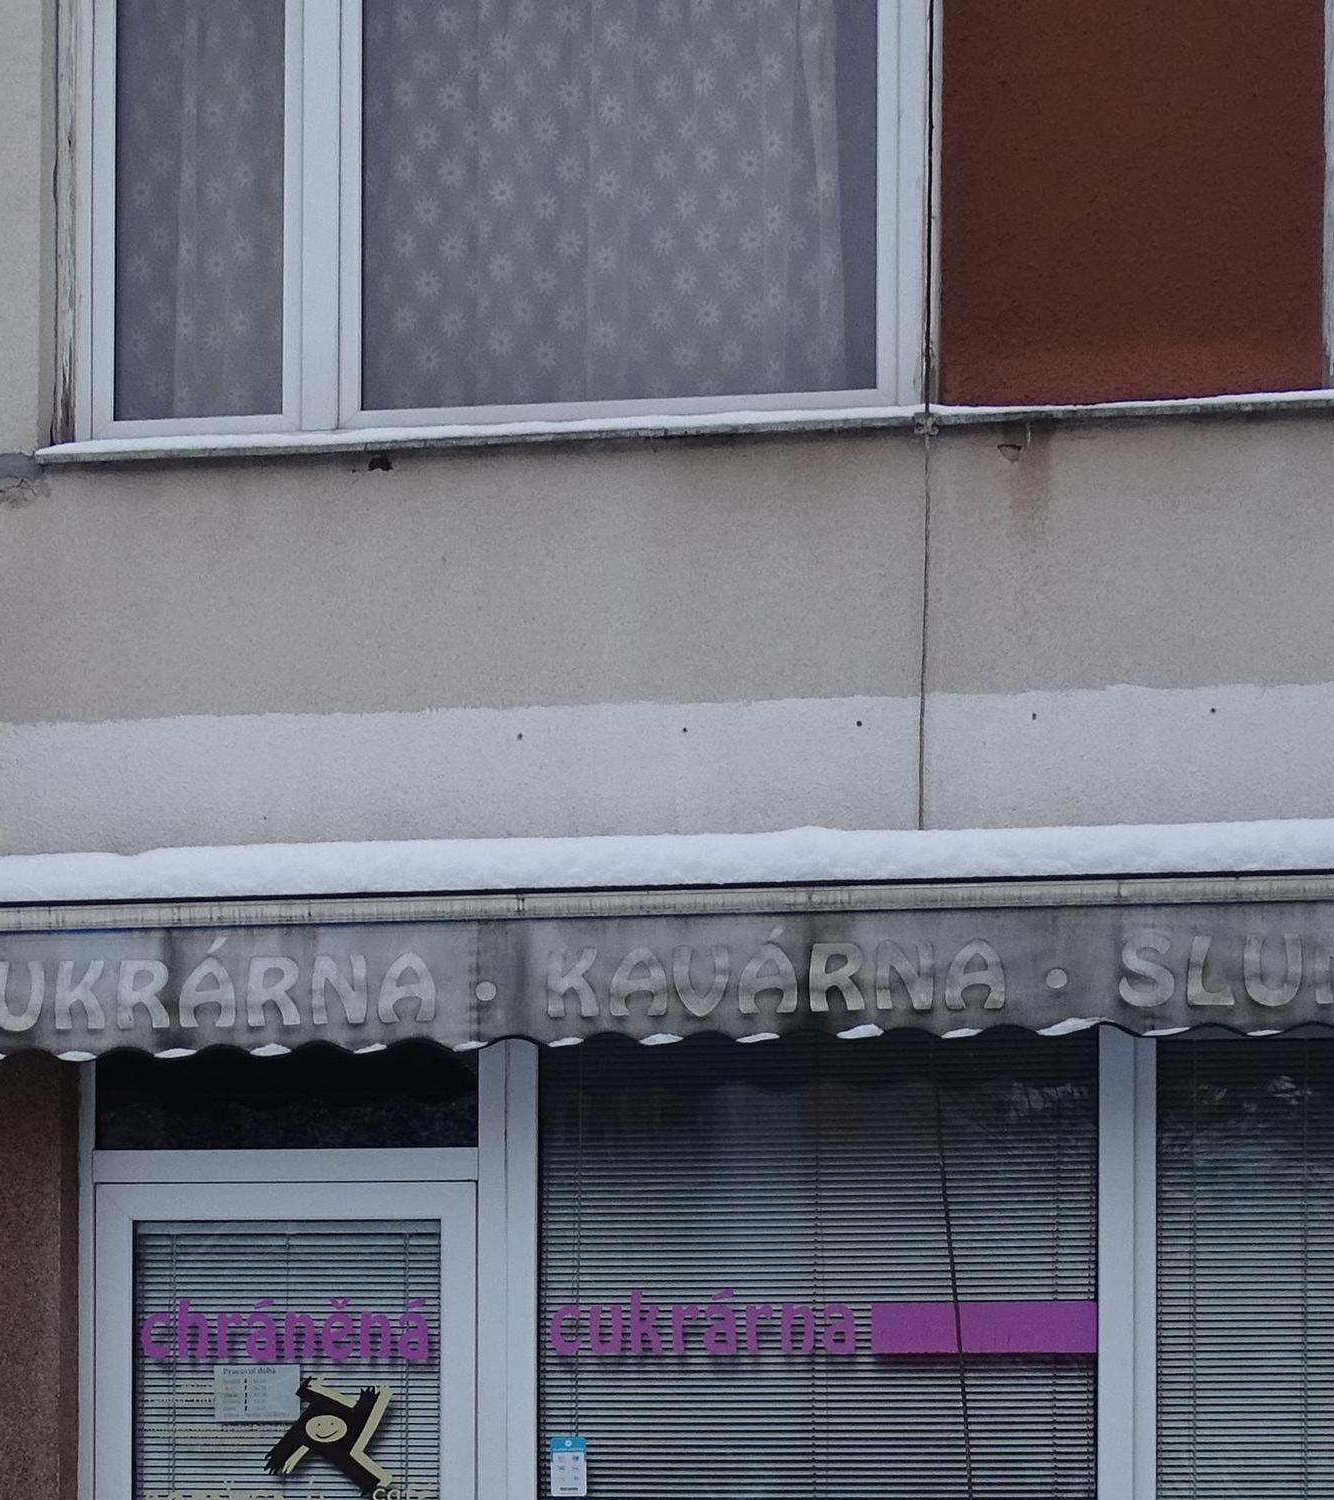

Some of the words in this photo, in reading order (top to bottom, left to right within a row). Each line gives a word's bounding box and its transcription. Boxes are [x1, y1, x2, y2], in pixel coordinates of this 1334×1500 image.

[545, 925, 1006, 1019] KAVÁRNA
[141, 1297, 429, 1361] chráněná
[549, 1288, 856, 1355] cukrárna
